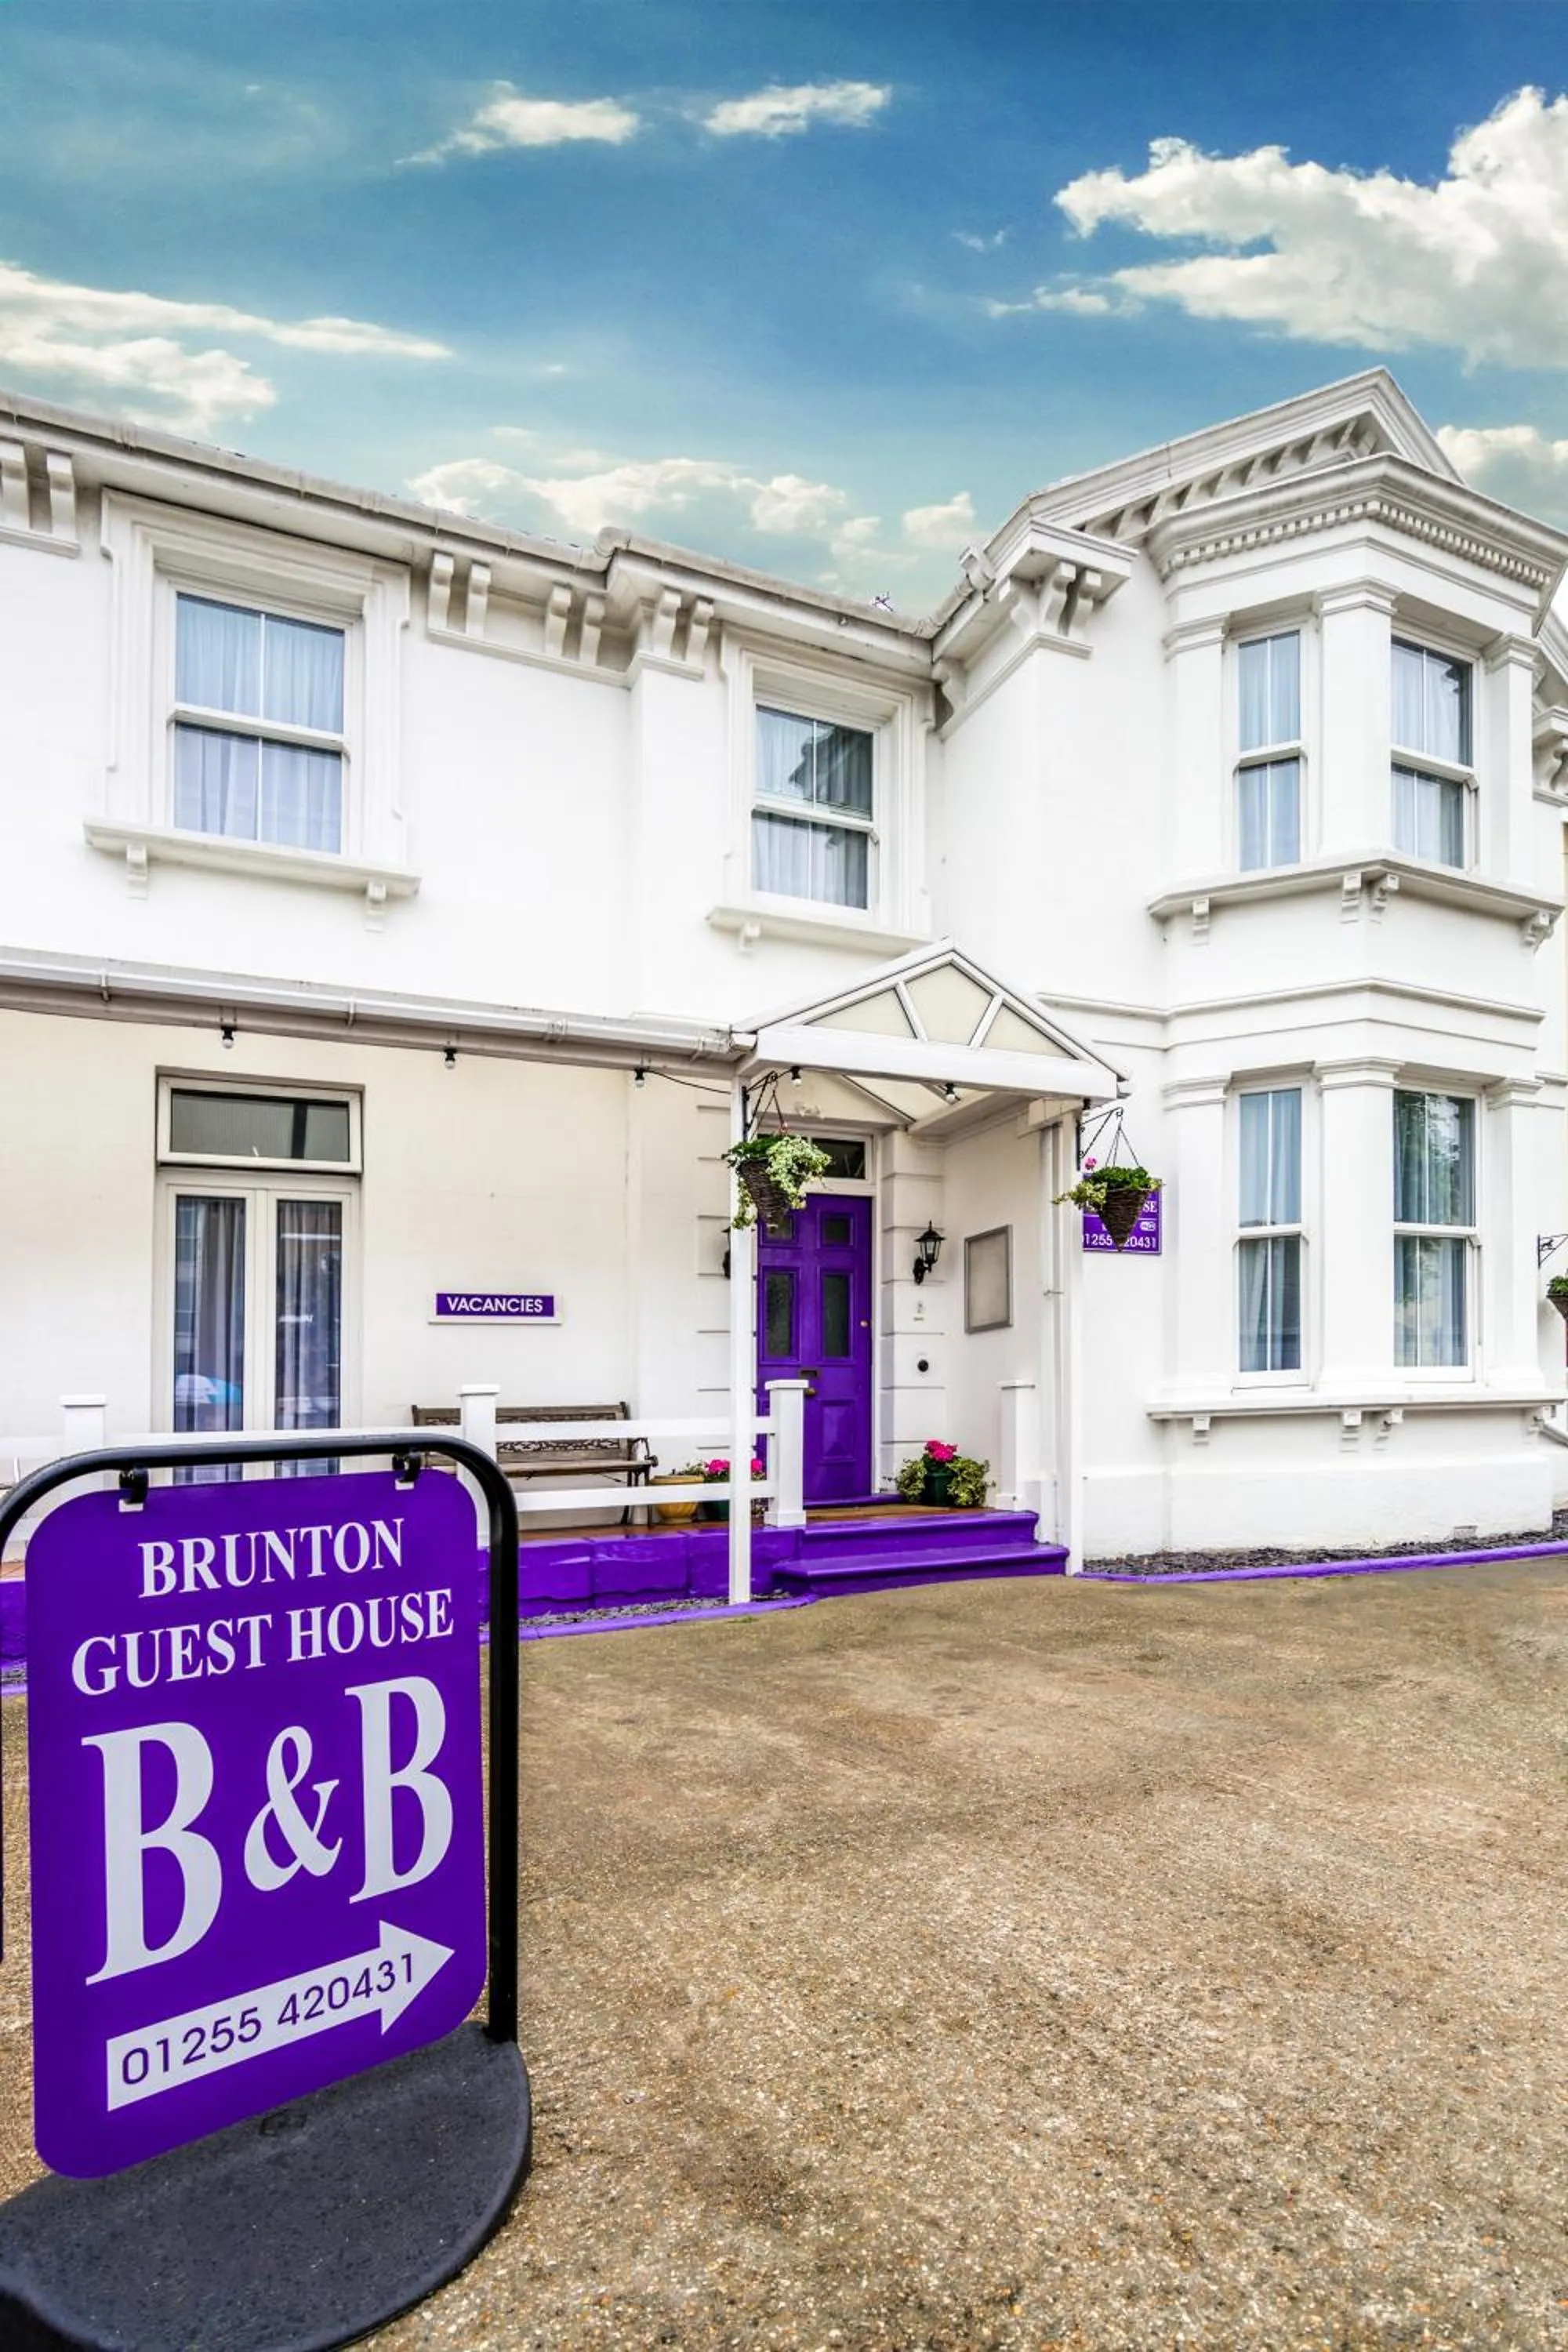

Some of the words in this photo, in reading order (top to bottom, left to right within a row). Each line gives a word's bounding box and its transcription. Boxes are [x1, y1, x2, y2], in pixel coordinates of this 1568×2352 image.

[447, 1296, 543, 1312] VACANCIES
[138, 1518, 405, 1598] BRUNTON
[72, 1613, 273, 1696] GUEST
[286, 1588, 454, 1663] HOUSE
[81, 1676, 454, 1986] B&B
[122, 2006, 262, 2085] 01255
[277, 1954, 416, 2026] 420431
